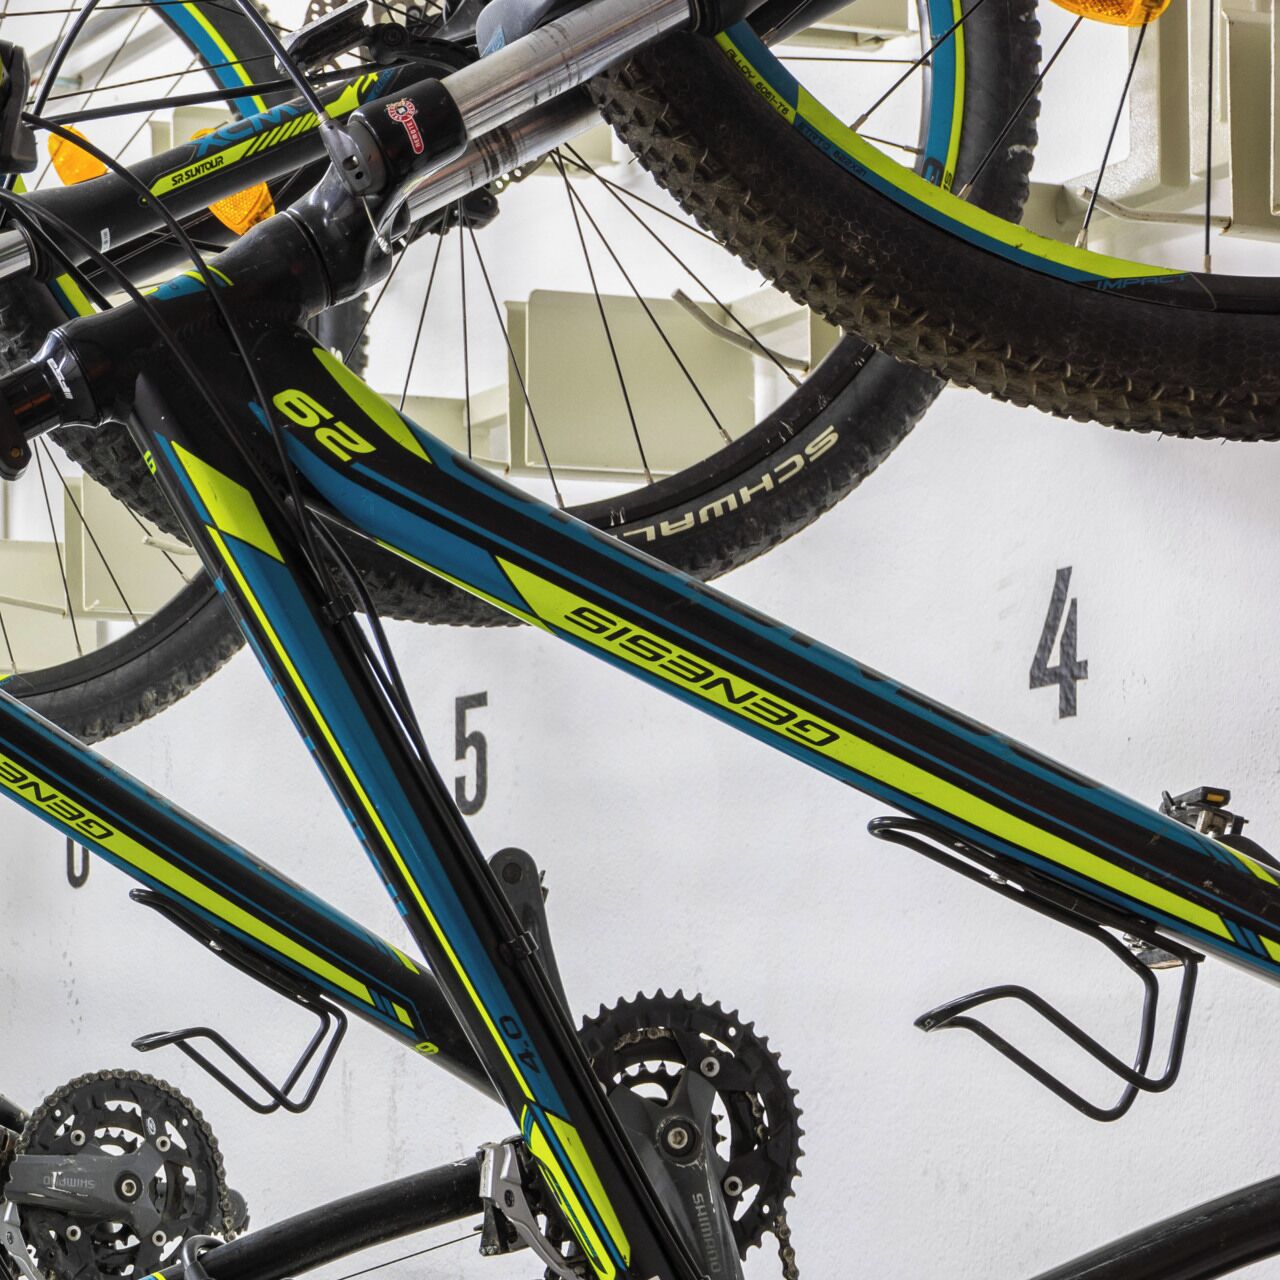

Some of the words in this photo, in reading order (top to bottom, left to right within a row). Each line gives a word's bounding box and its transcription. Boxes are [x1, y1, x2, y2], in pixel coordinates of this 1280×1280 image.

[192, 103, 301, 157] XCM
[171, 171, 185, 187] SR
[184, 155, 224, 183] SUNTOUR
[272, 388, 377, 463] 29
[615, 425, 838, 542] SCHWAL
[564, 606, 842, 747] GENESIS
[1029, 566, 1089, 720] 4
[455, 691, 488, 816] 5
[498, 1015, 541, 1074] 4.0
[692, 1193, 721, 1273] SHIMANO
